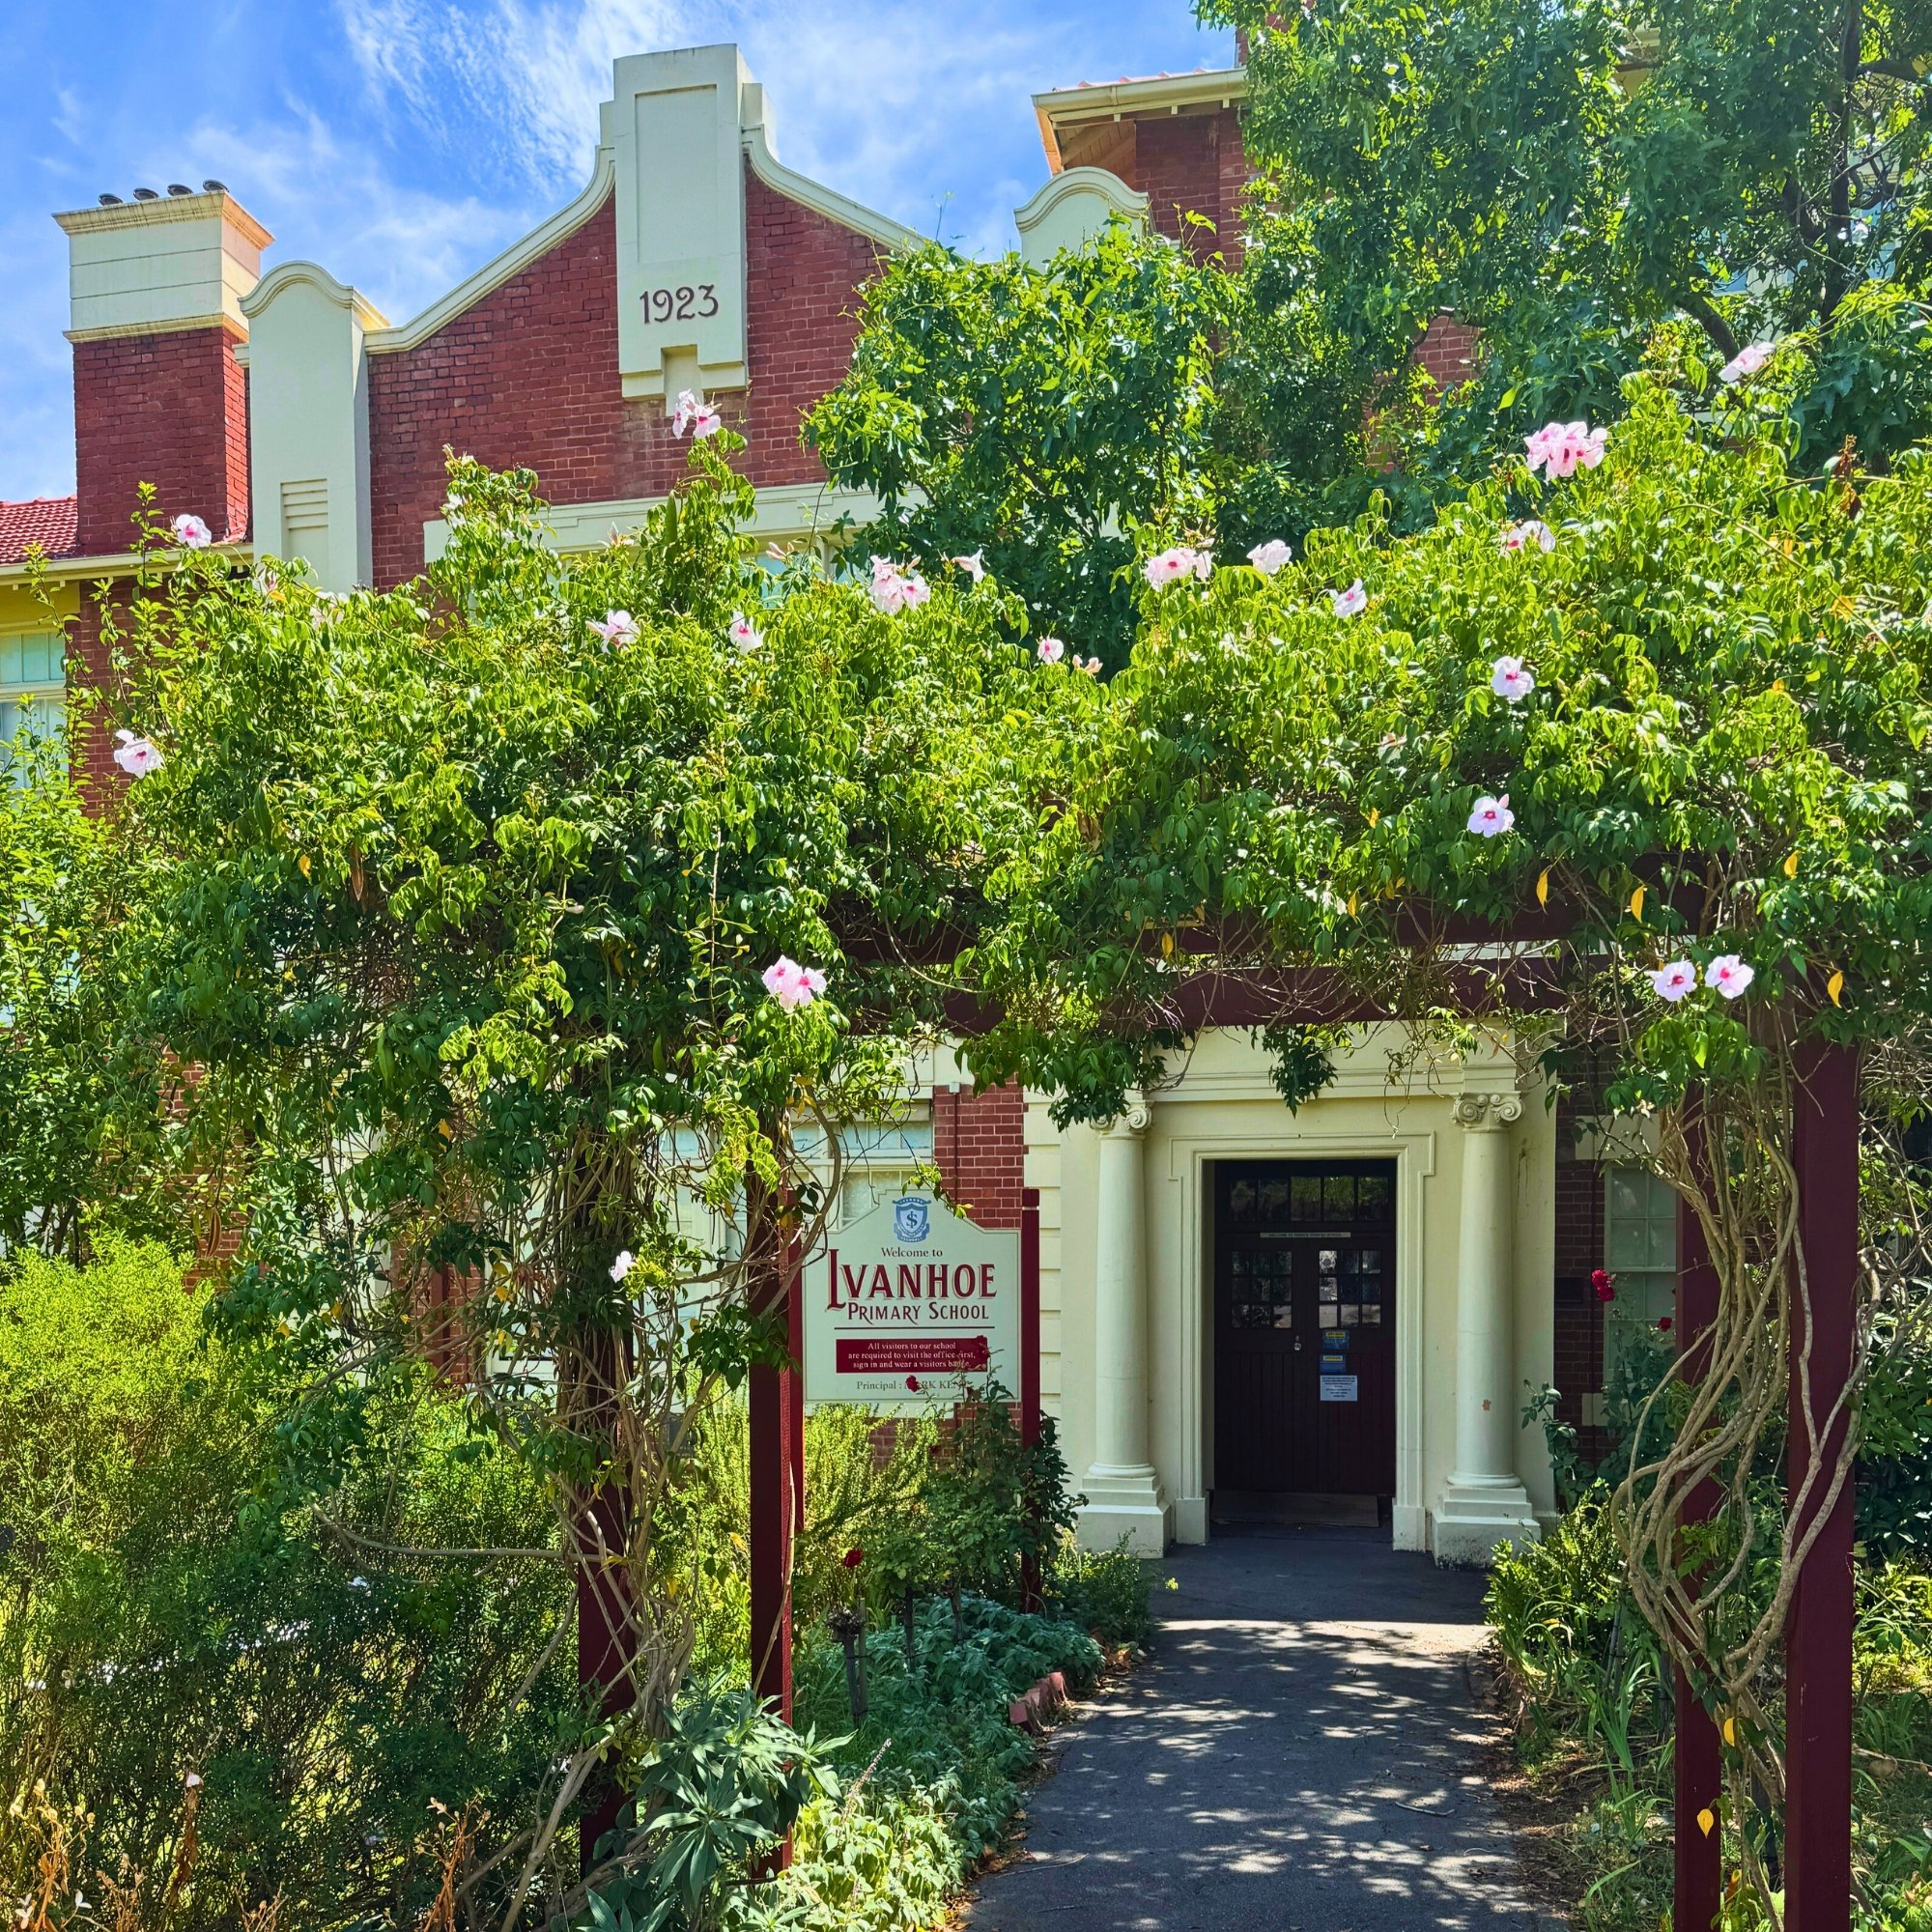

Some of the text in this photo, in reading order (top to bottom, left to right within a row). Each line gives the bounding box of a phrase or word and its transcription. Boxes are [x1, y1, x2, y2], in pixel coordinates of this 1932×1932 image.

[639, 283, 719, 325] 1923
[881, 1247, 943, 1258] Welcome to
[825, 1248, 997, 1312] IVANHOE
[847, 1301, 989, 1324] PRIMARY SCHOOL
[867, 1342, 880, 1350] All
[882, 1342, 909, 1350] visitors
[861, 1351, 893, 1361] required
[853, 1360, 869, 1370] sign
[857, 1379, 897, 1392] Principal
